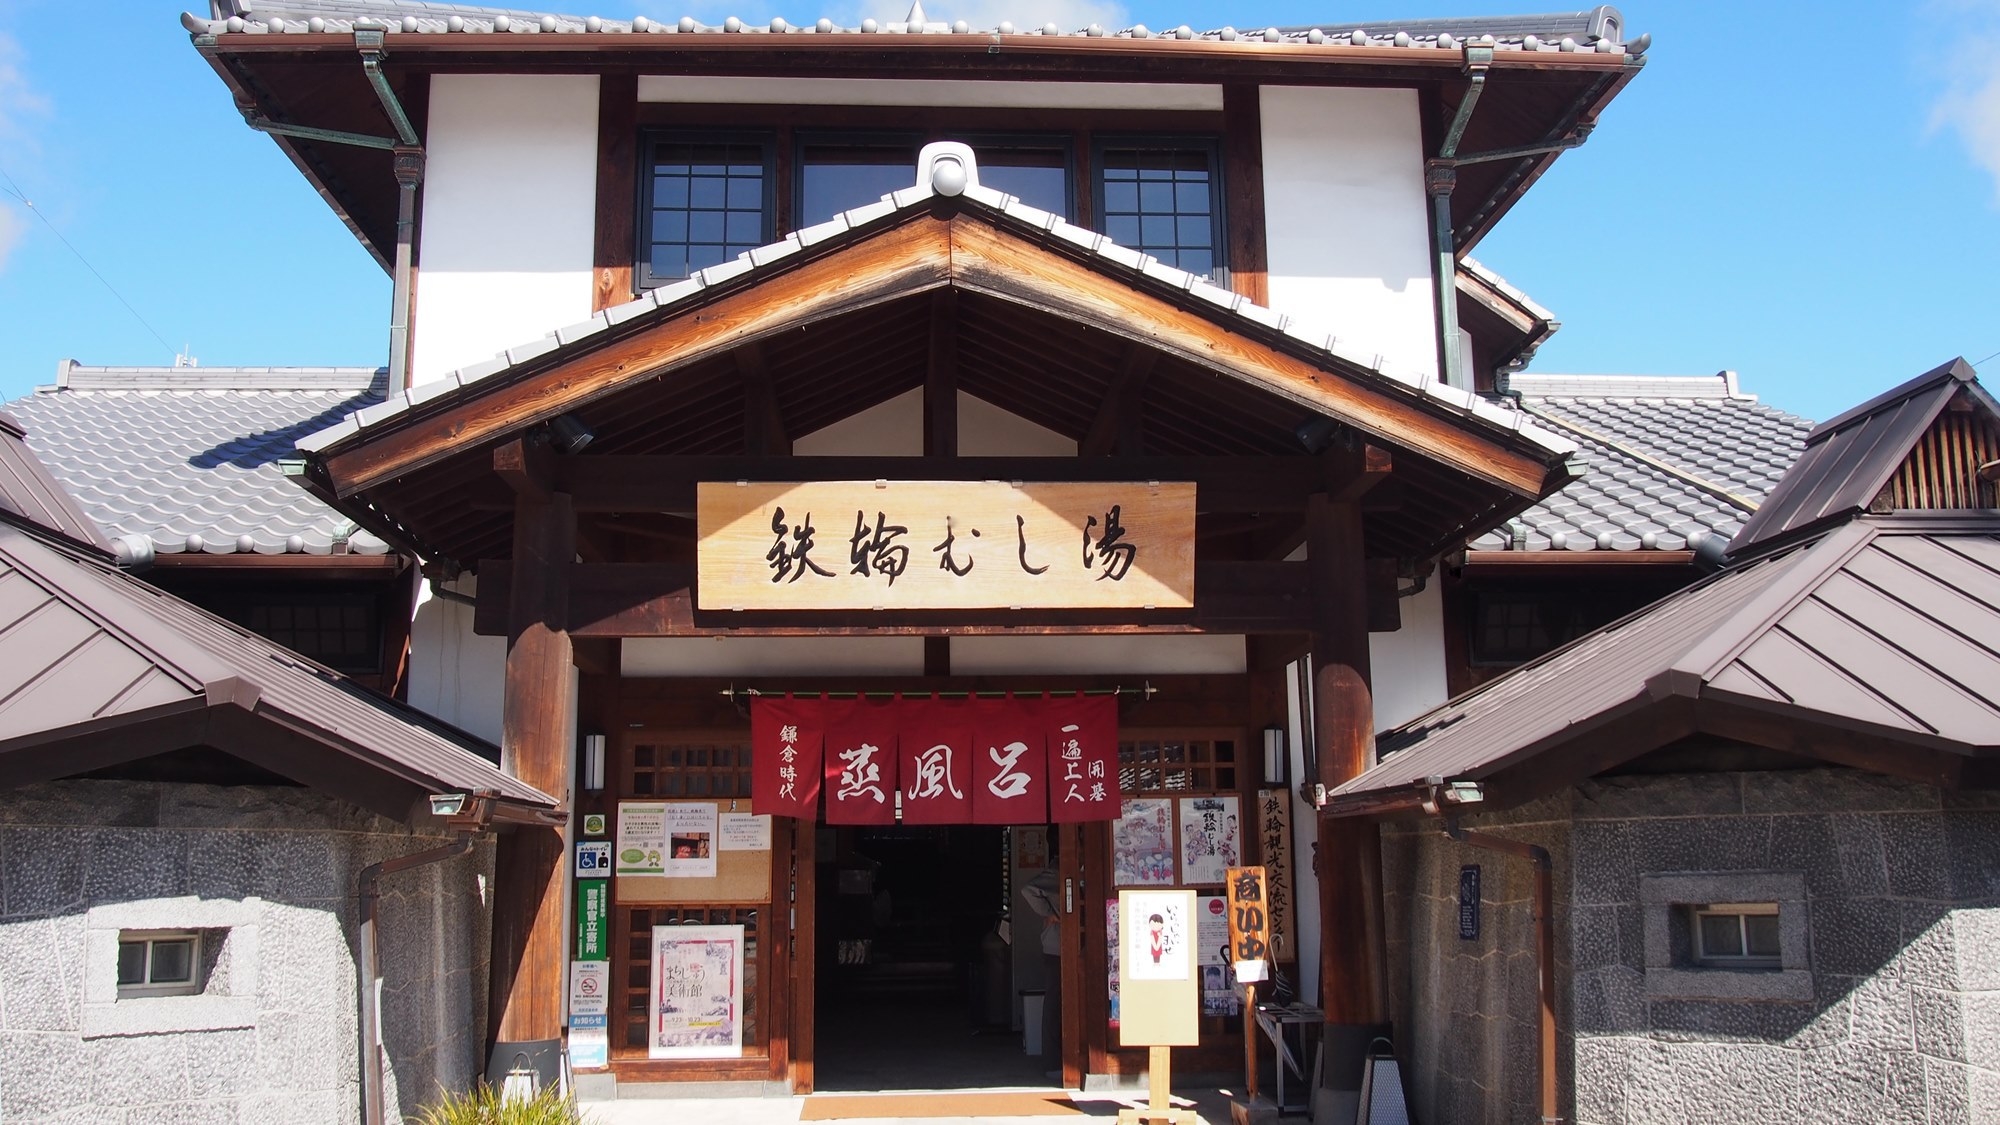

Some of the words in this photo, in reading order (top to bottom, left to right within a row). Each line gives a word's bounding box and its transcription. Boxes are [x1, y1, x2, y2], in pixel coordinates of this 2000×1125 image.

[766, 504, 1139, 587] 鉄輪むし湯
[779, 724, 798, 803] 鎌倉時代
[837, 741, 1032, 803] 蒸風呂
[1061, 723, 1085, 803] 一遍上人
[1087, 759, 1107, 803] 開基
[585, 888, 598, 954] 警察官立寄所
[1234, 874, 1265, 960] 商い中
[574, 1015, 602, 1025] お知らせ
[665, 983, 703, 998] 美術館
